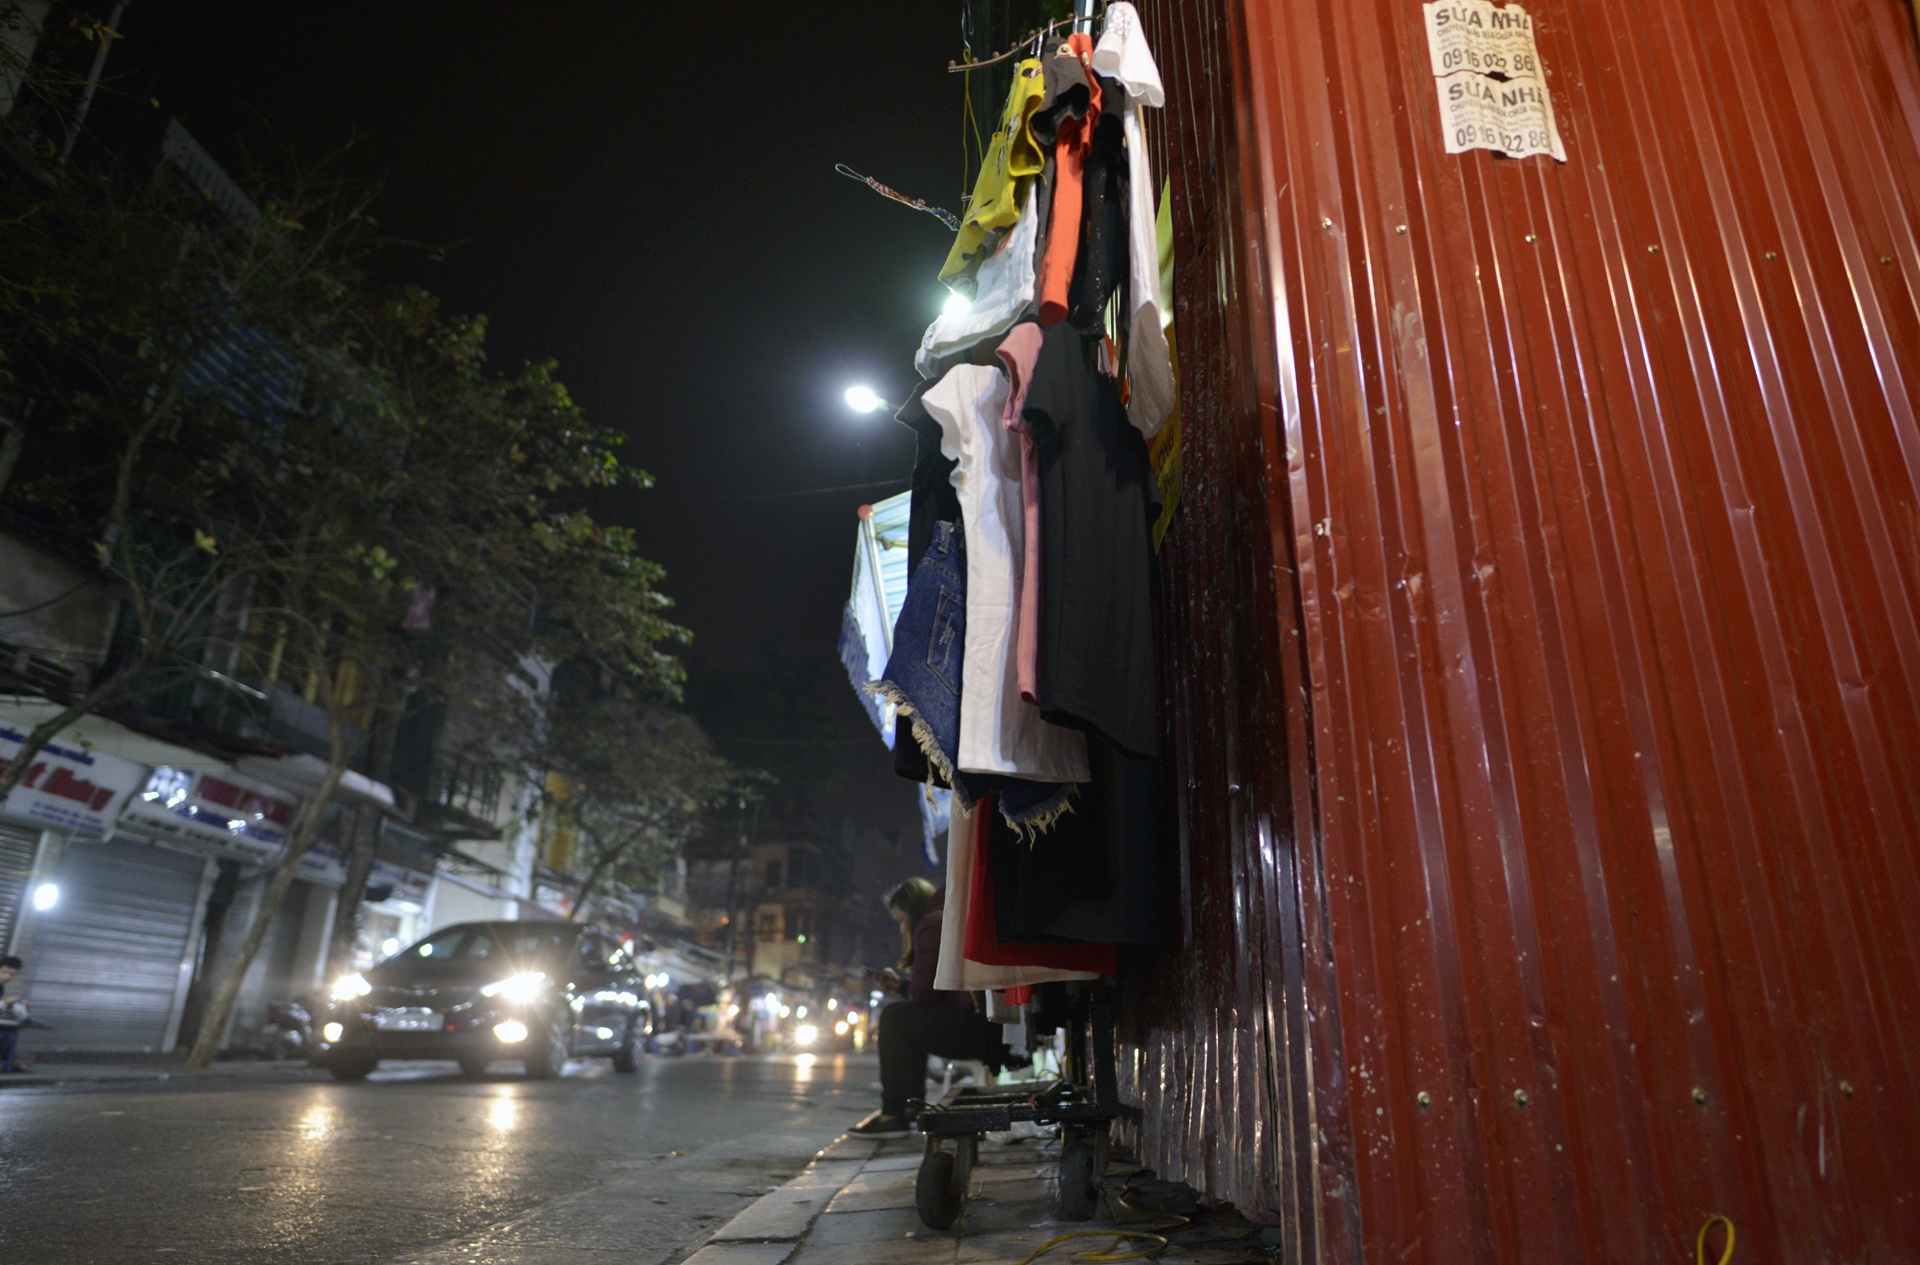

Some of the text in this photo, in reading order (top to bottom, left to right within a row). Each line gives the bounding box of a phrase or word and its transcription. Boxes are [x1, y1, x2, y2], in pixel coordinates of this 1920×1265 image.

[1435, 0, 1483, 29] SỬA
[1443, 47, 1480, 69] 0916
[1448, 74, 1496, 103] SỬA
[1456, 124, 1496, 147] 0916
